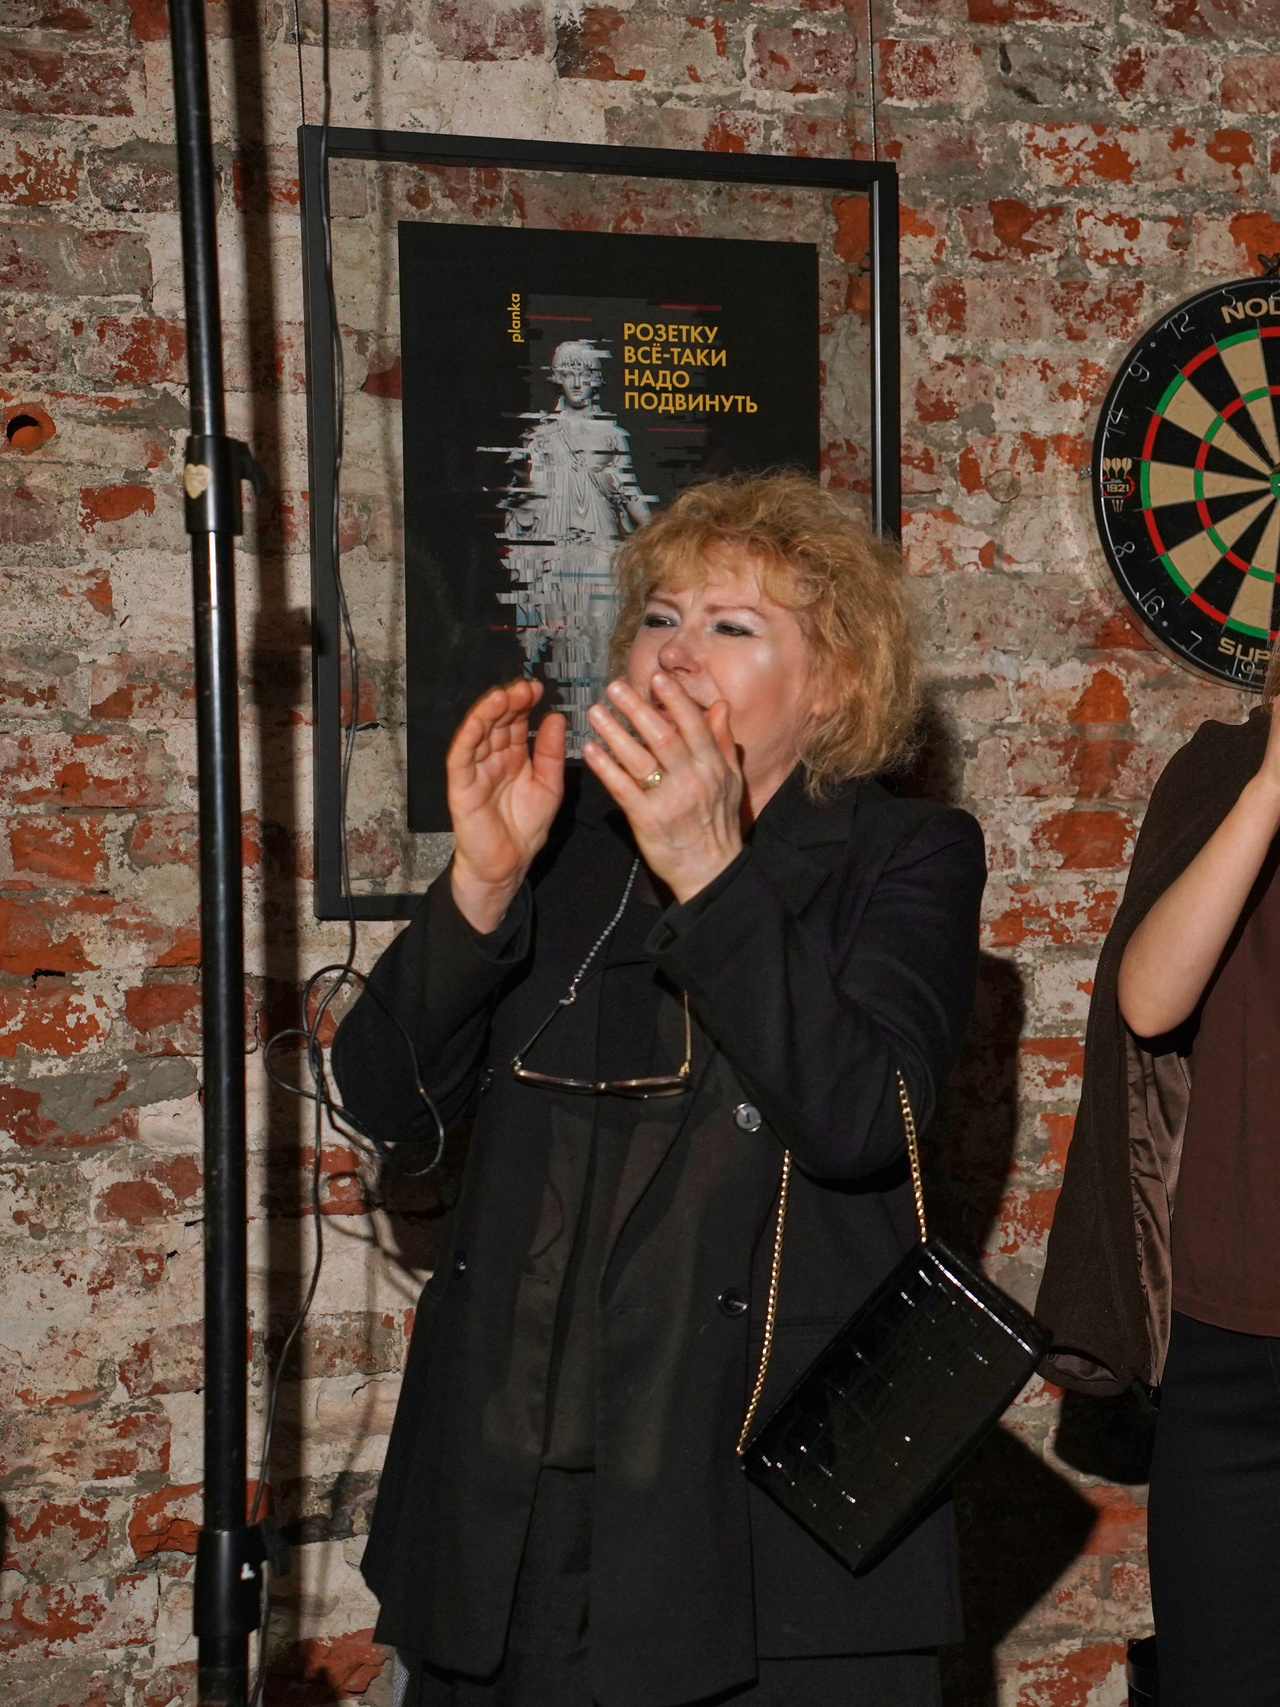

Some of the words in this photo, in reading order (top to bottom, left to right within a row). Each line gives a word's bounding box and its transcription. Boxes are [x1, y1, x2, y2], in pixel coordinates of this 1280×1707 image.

[507, 293, 525, 343] planka
[1163, 310, 1196, 340] 12
[623, 322, 719, 344] РОЗЕТКУ
[624, 342, 727, 367] ВСЁ-ТАКИ
[624, 368, 690, 391] НАДО
[624, 391, 759, 414] ПОДВИНУТЬ
[1106, 483, 1130, 493] 1921
[1136, 588, 1165, 617] 16
